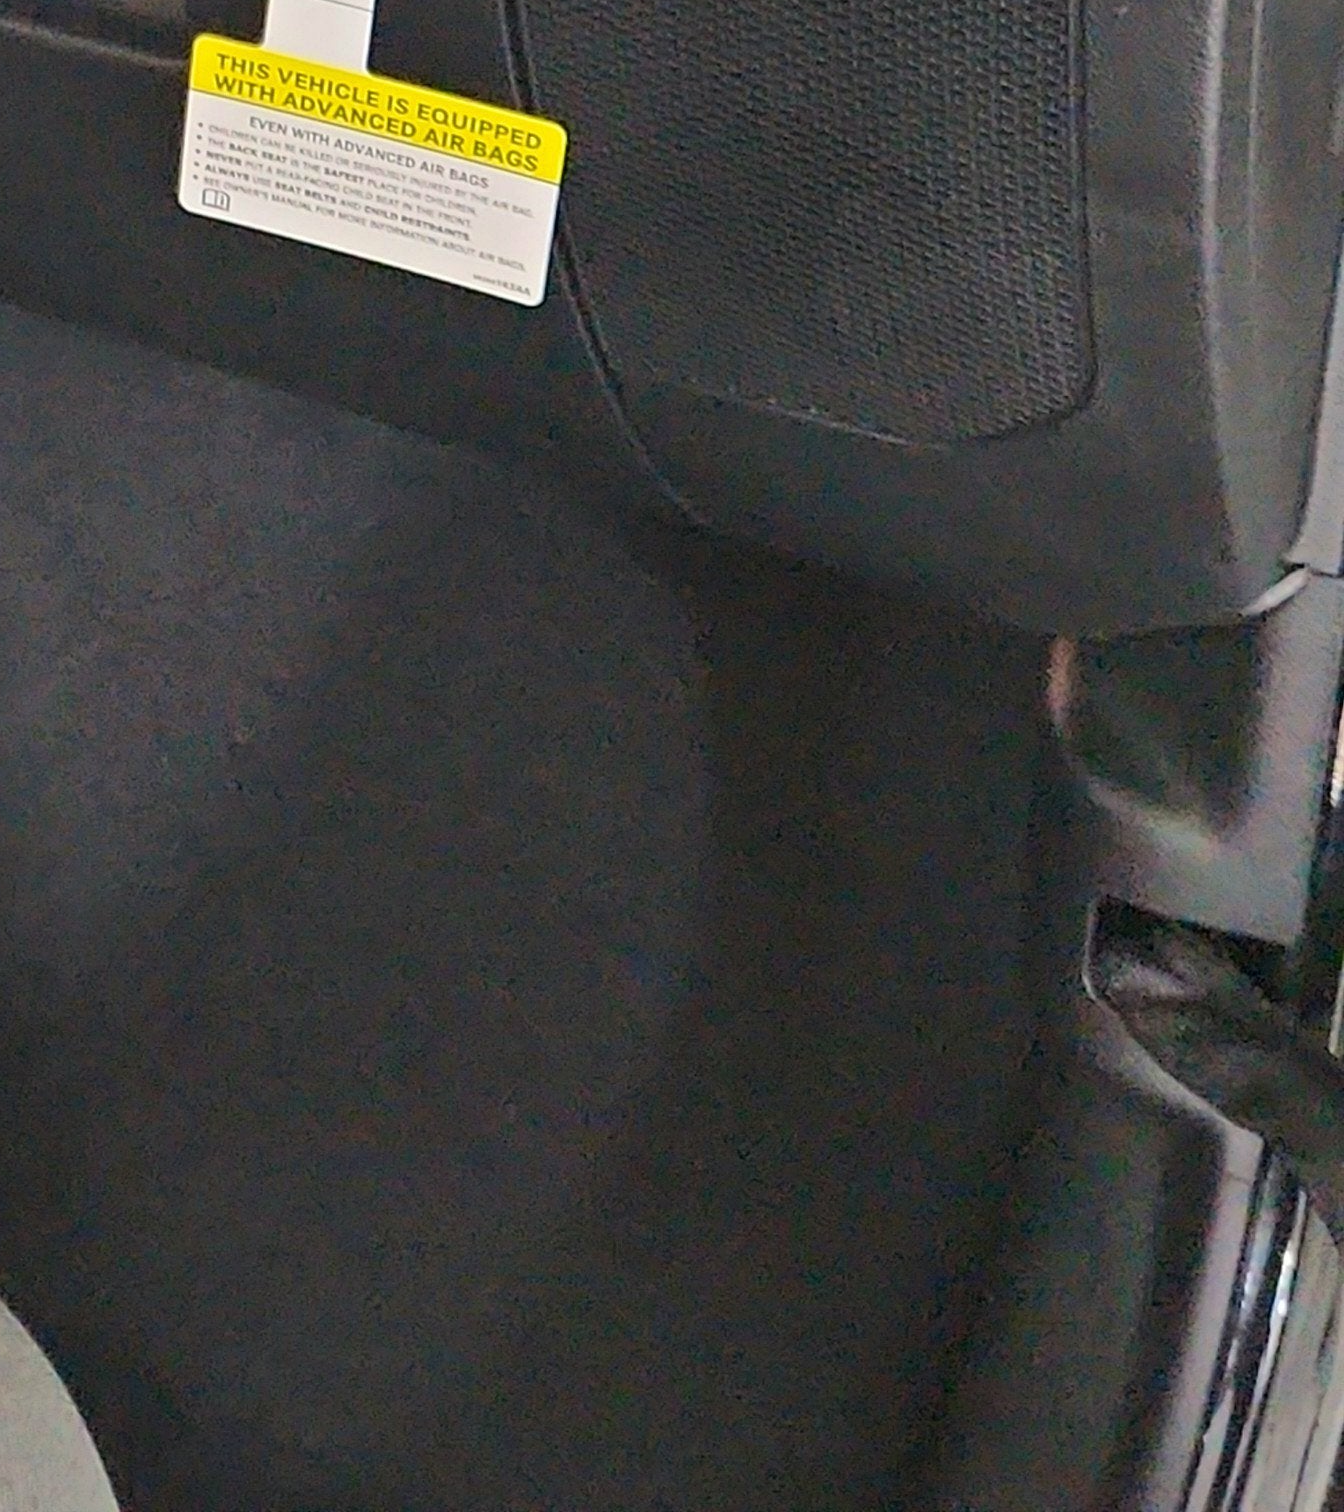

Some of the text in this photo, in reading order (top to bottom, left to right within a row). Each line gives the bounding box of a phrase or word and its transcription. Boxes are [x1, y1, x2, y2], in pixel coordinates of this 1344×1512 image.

[213, 73, 539, 172] WITH ADVANCED AIR BAGS
[216, 52, 541, 150] THIS VEHICLE IS EQUIPPED
[206, 150, 242, 166] NEVER
[229, 142, 259, 157] BACK
[261, 151, 287, 164] SEAT
[323, 167, 364, 184] SAFEST
[249, 116, 490, 189] EVEN WITH ADVANCED AIR BAGS
[205, 164, 249, 181] ALWAYS
[275, 182, 301, 194] SEAT
[304, 189, 337, 204] BELTS
